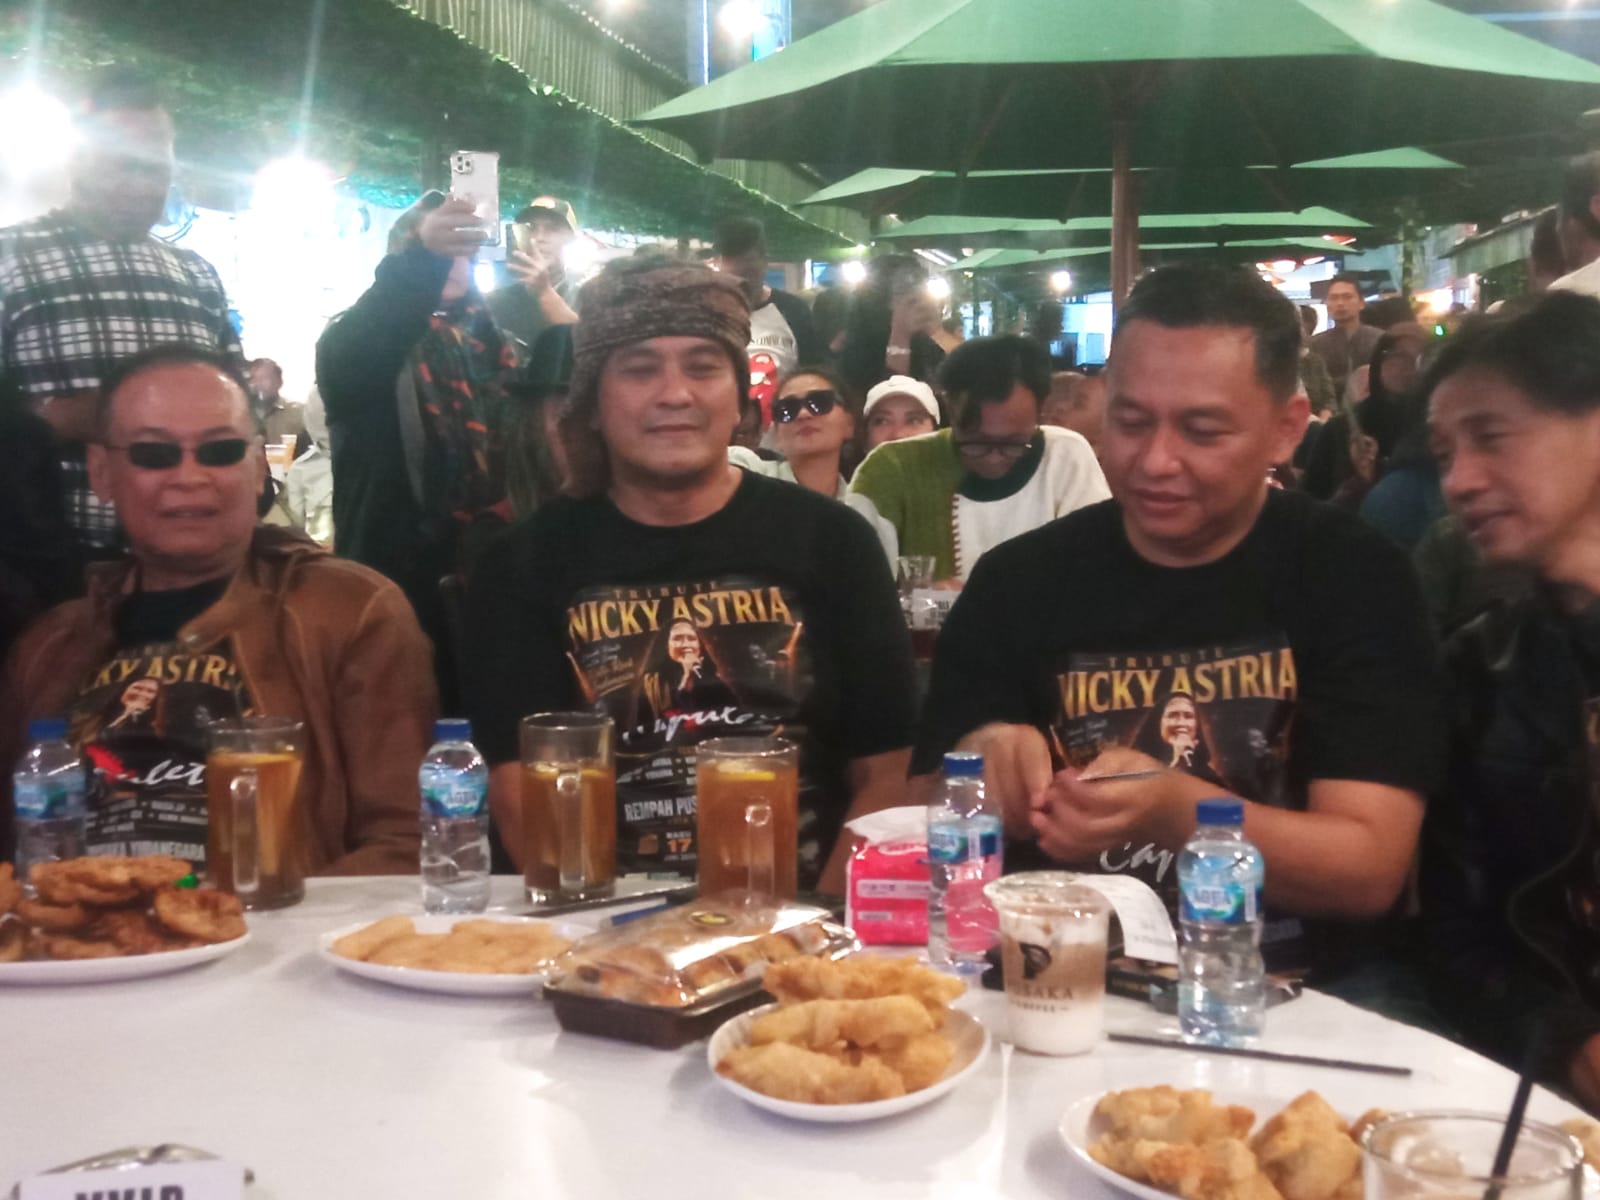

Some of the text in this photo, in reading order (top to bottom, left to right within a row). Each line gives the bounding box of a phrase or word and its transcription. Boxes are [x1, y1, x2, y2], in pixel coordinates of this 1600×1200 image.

[613, 580, 718, 600] TRIBUTE
[568, 586, 796, 642] NICKY ASTRIA
[1057, 647, 1298, 720] NICKY ASTRIA
[624, 800, 674, 822] REMPAH
[667, 838, 692, 853] 17
